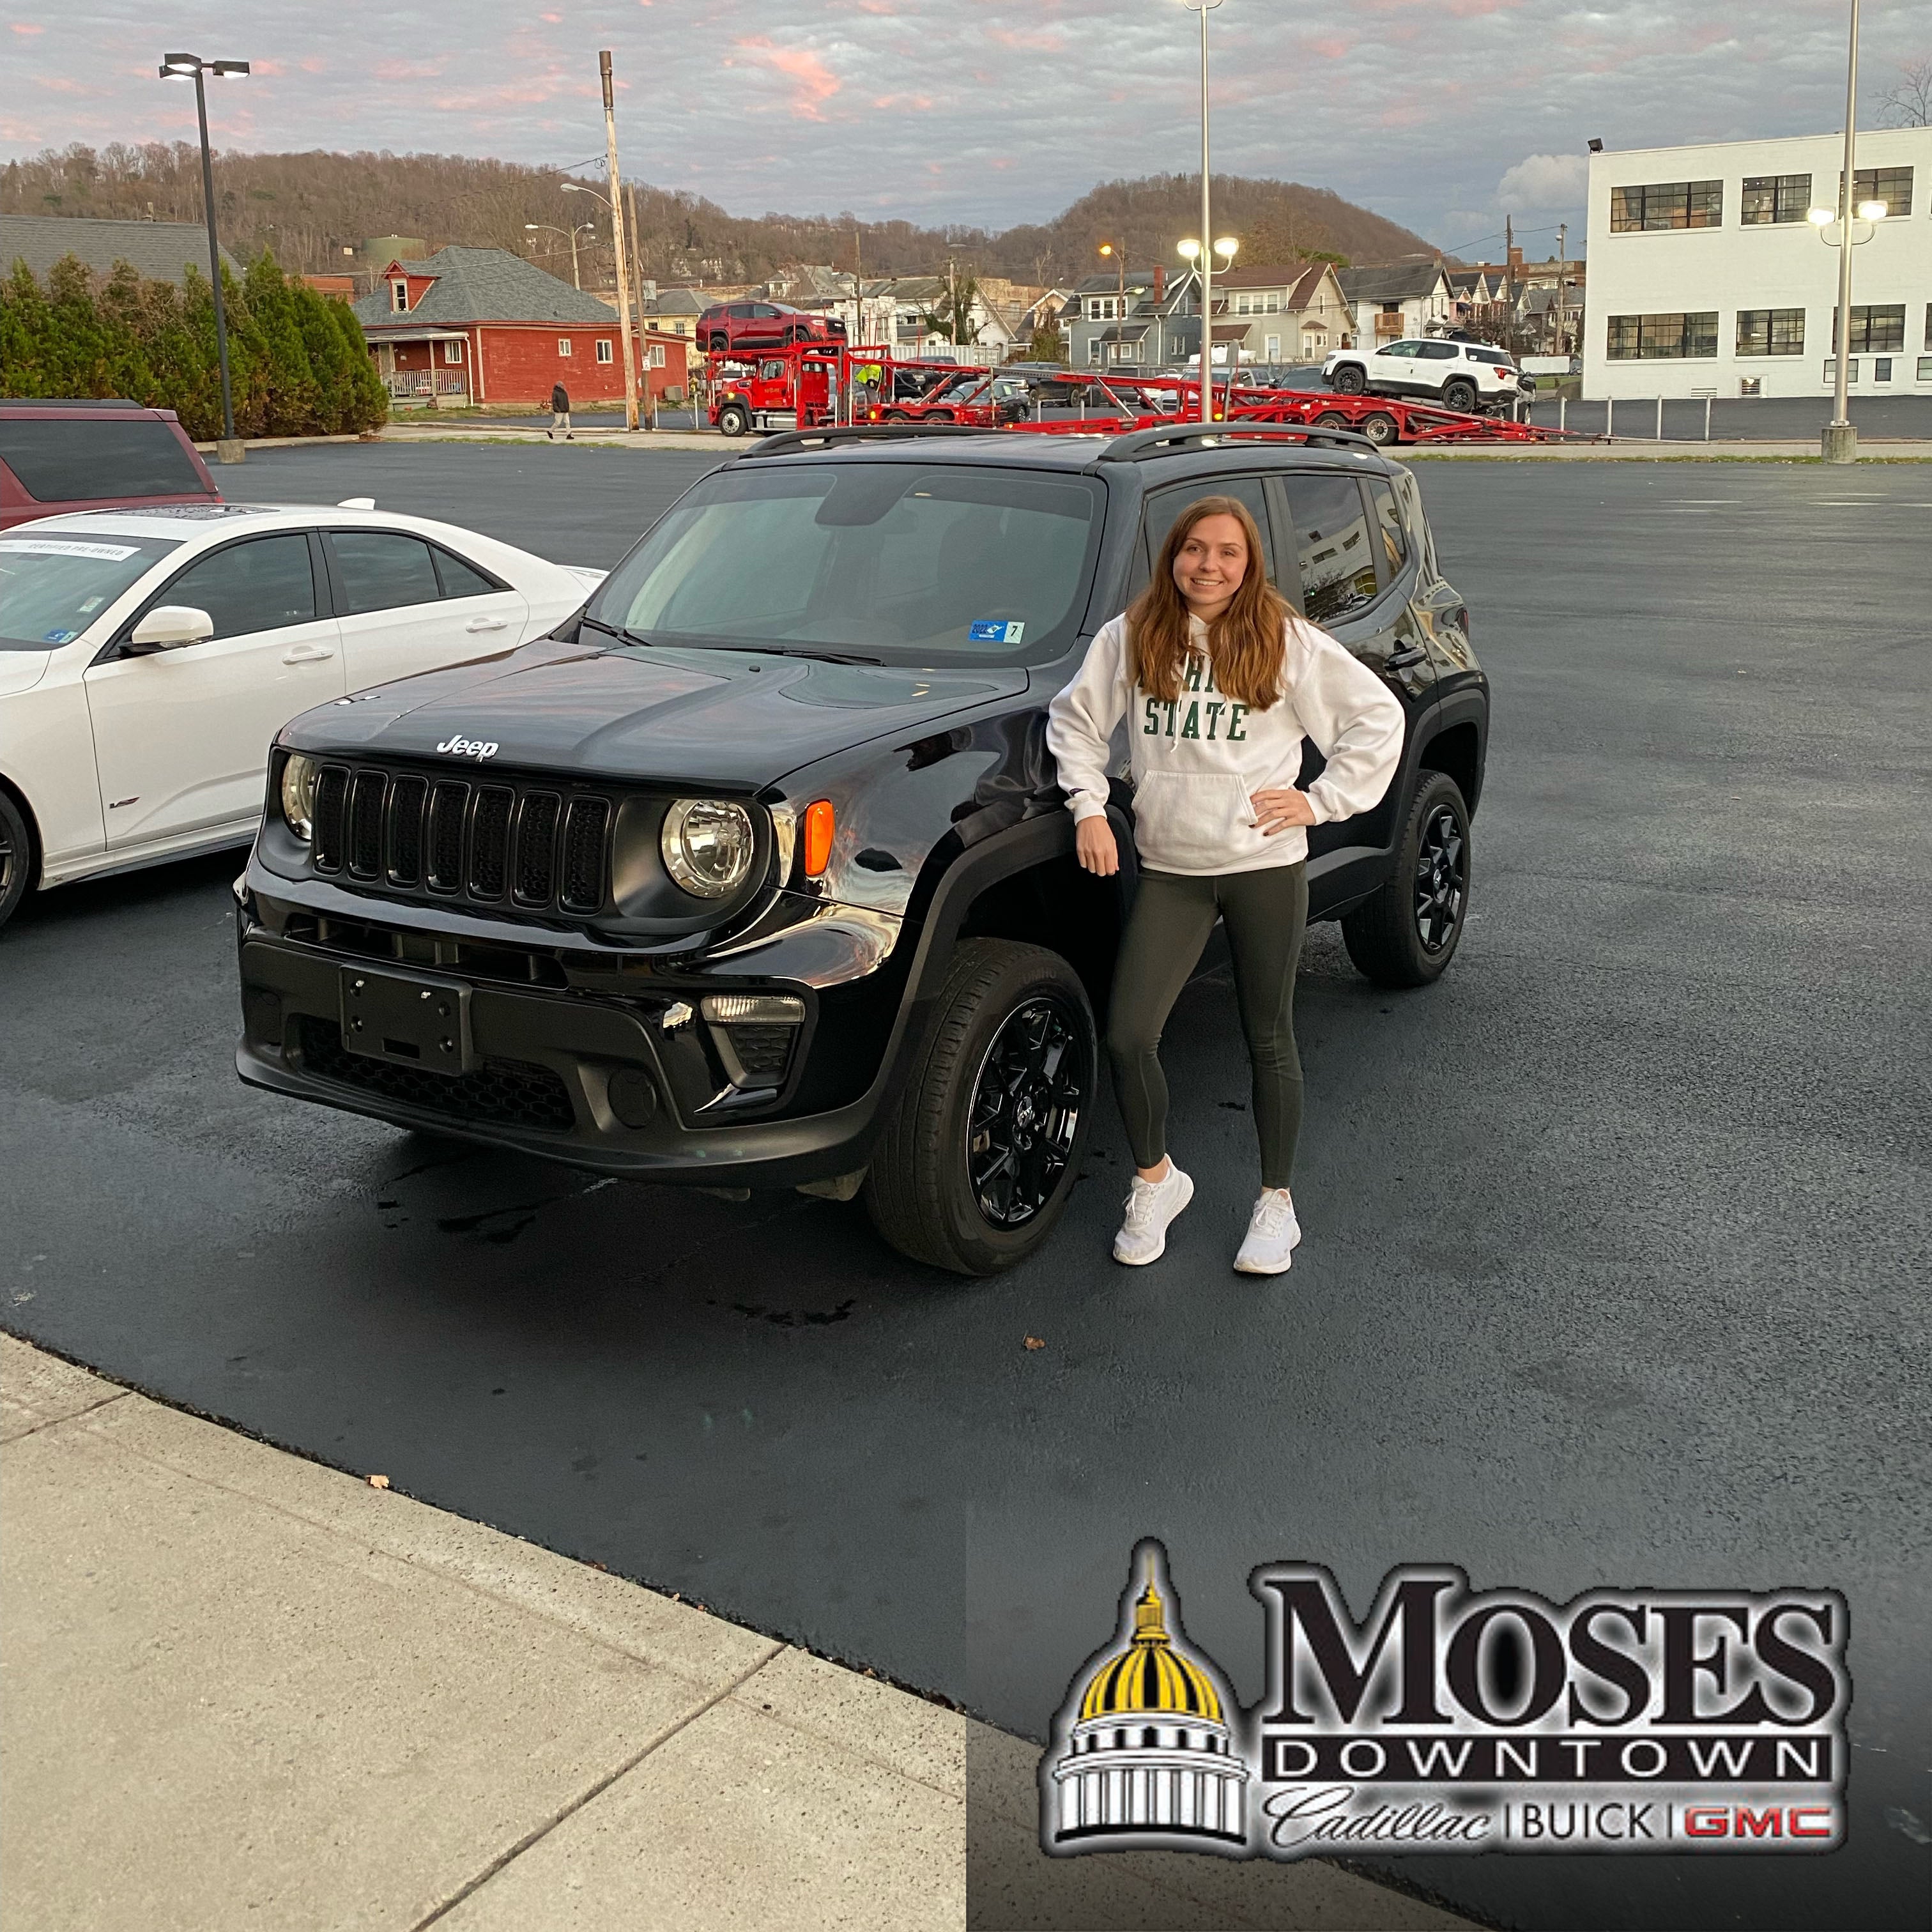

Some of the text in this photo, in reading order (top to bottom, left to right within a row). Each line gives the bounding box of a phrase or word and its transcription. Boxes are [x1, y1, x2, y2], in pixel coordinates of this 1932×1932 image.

[71, 546, 124, 556] PRE-OWNED
[1011, 625, 1018, 637] 7
[1144, 697, 1250, 740] STATE
[436, 735, 500, 763] Jeep
